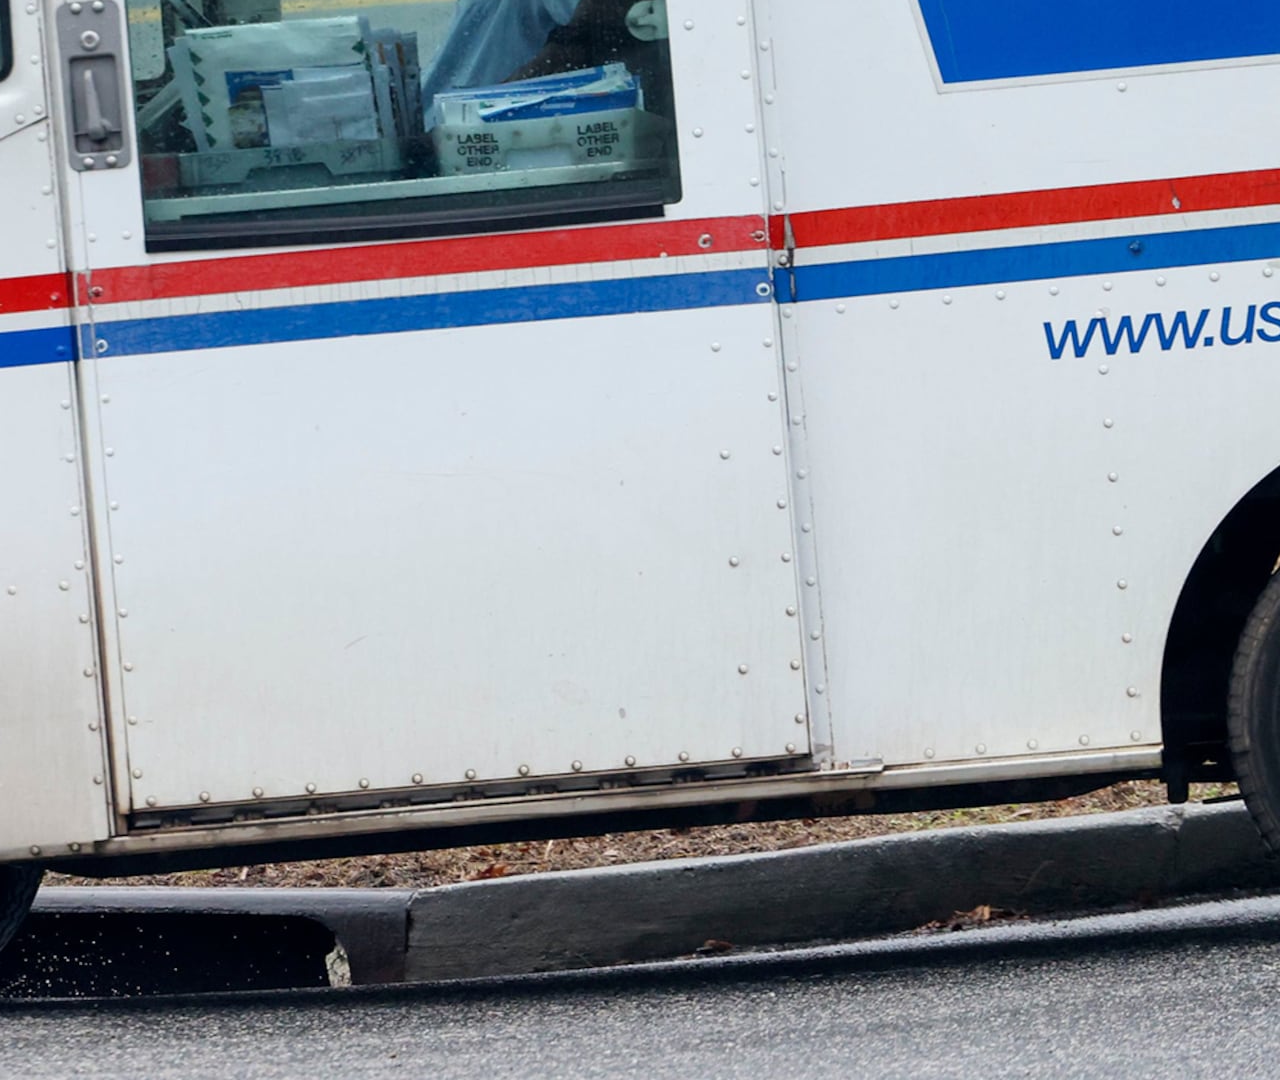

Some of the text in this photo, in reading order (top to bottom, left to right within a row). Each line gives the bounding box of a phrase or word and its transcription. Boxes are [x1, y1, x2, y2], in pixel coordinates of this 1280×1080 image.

[577, 122, 617, 135] LABEL
[457, 133, 499, 145] LABEL
[577, 133, 619, 147] OTHER
[457, 144, 500, 156] OTHER
[587, 146, 613, 157] END
[466, 156, 493, 167] END
